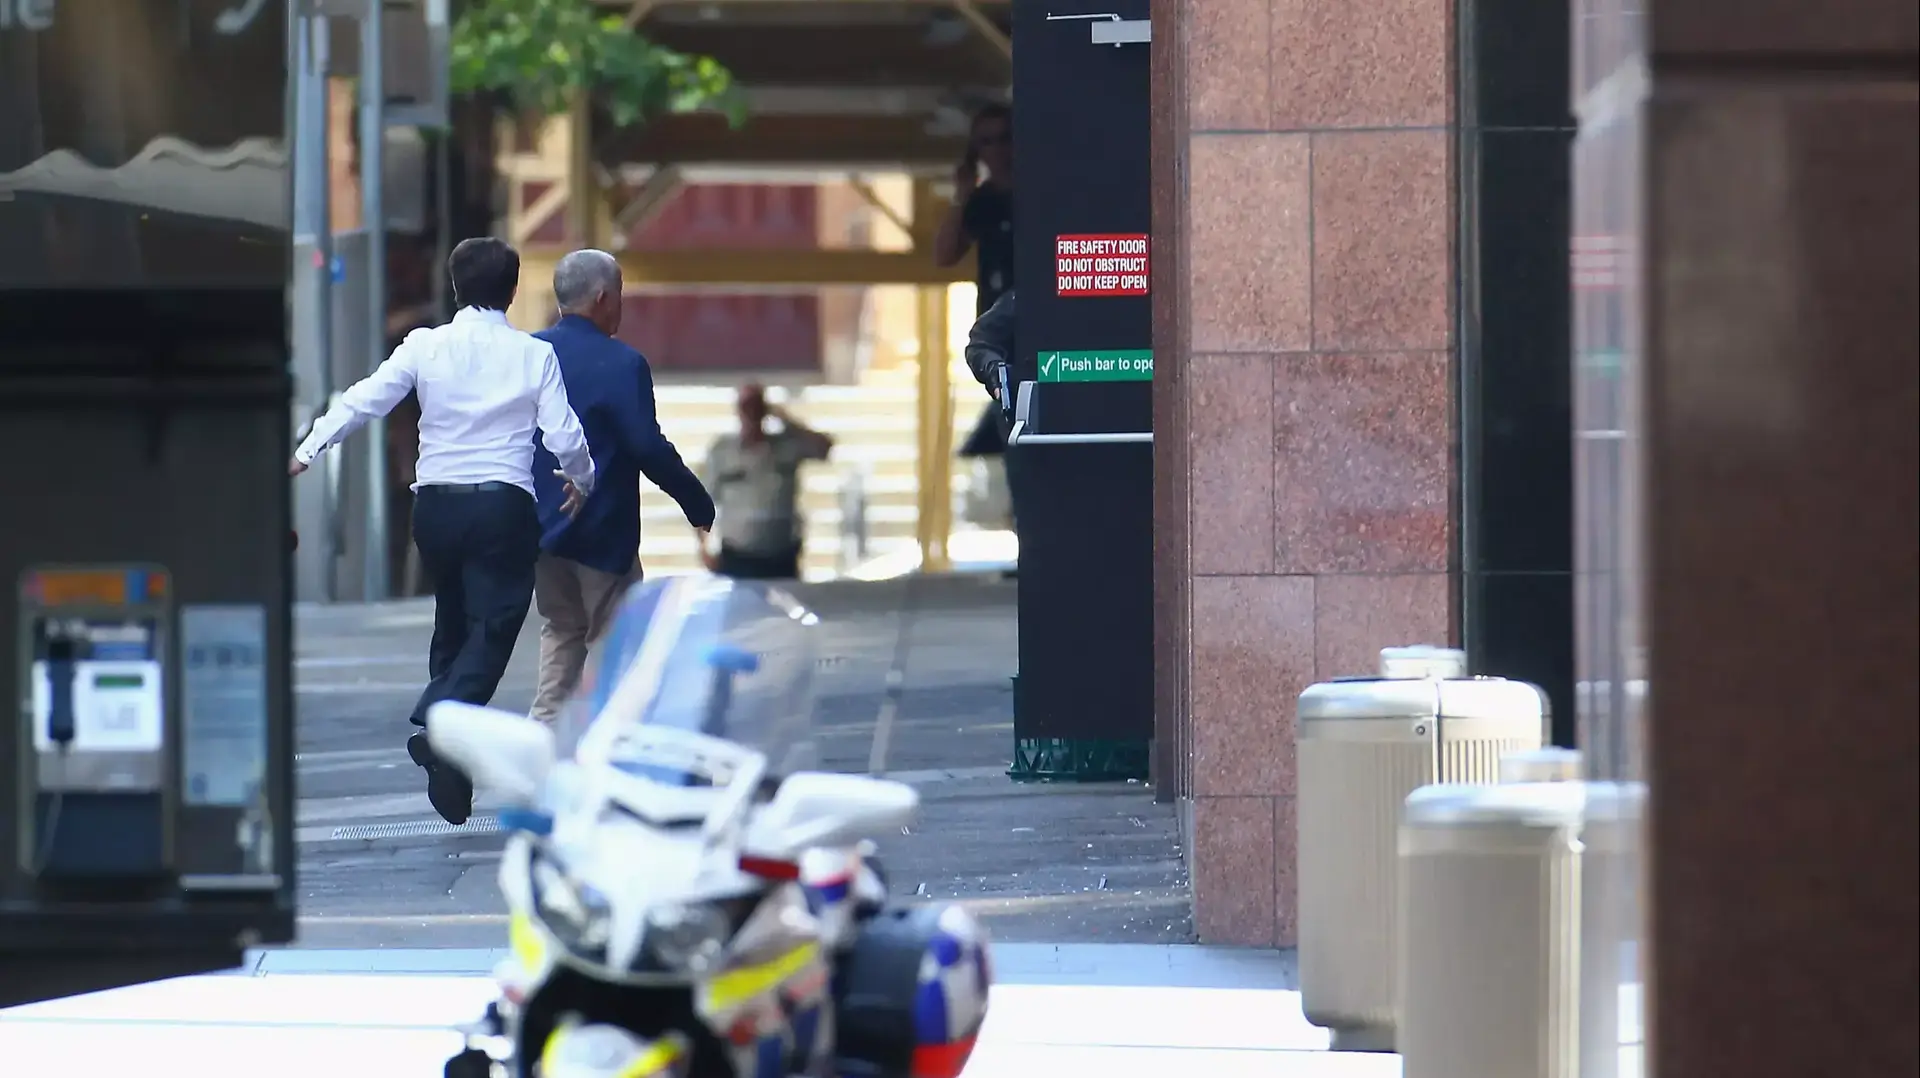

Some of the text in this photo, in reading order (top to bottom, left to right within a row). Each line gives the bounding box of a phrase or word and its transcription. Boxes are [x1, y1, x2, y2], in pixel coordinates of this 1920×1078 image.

[1058, 240, 1146, 254] FIRE SAFETY DOOR
[1058, 258, 1146, 272] DO NOT OBSTRUCT
[1058, 275, 1147, 290] DO NOT KEEP OPEN
[1061, 358, 1092, 371] Push
[1095, 357, 1115, 370] bar
[1118, 357, 1130, 370] to
